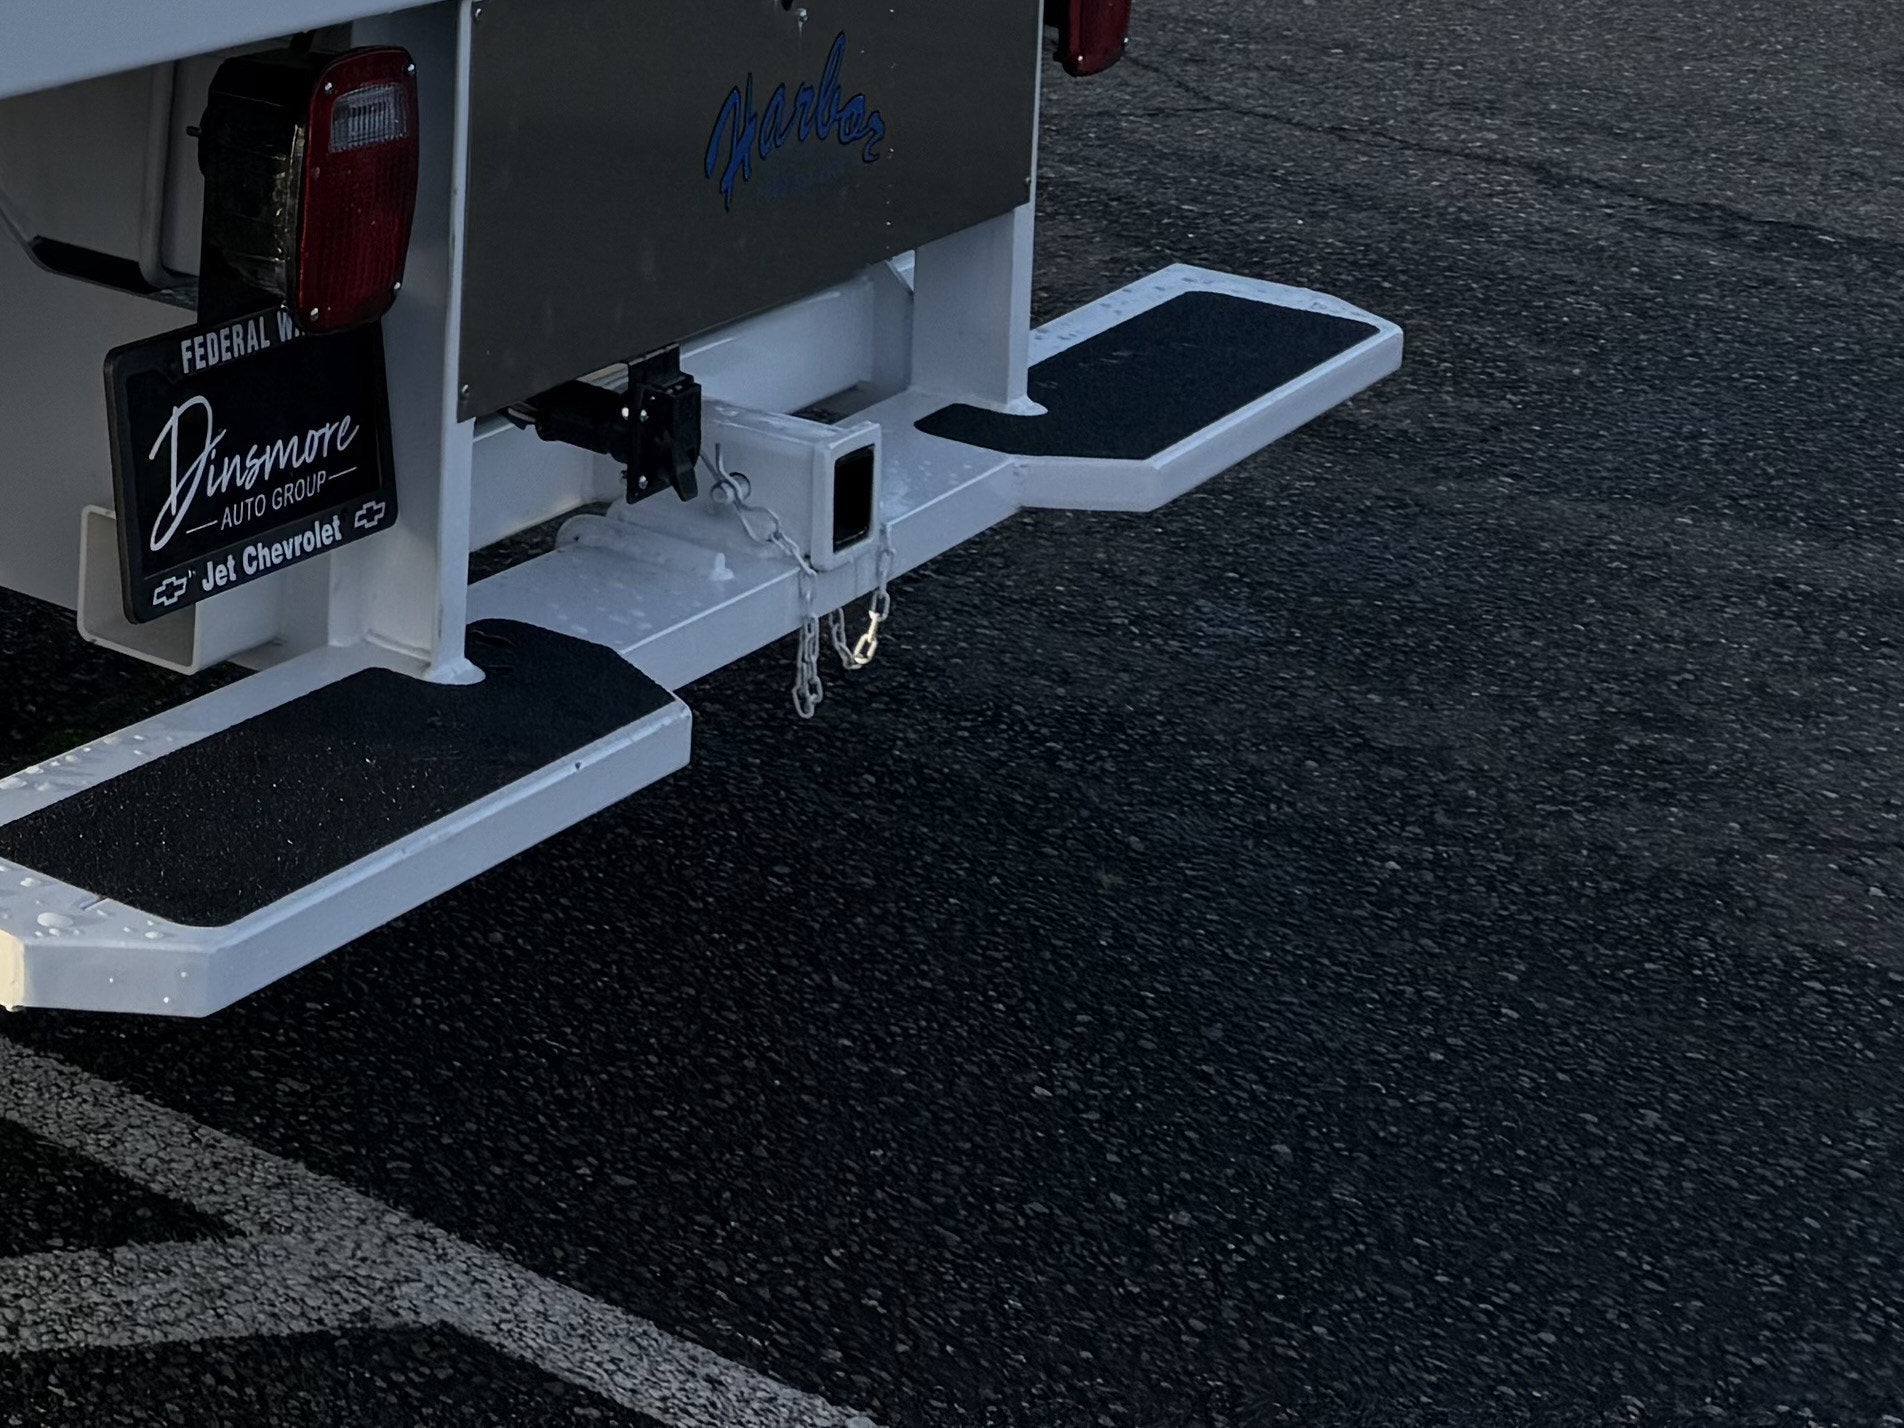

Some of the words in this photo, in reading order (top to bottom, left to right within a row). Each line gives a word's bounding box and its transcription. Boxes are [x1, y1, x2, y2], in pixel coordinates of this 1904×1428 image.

[704, 30, 886, 213] Harbor
[180, 315, 271, 374] FEDERAL
[149, 394, 360, 552] Dinsmore
[220, 495, 267, 532] AUTO
[272, 469, 328, 507] GROUP
[201, 553, 237, 593] Jet
[242, 513, 344, 577] Chevrolet
